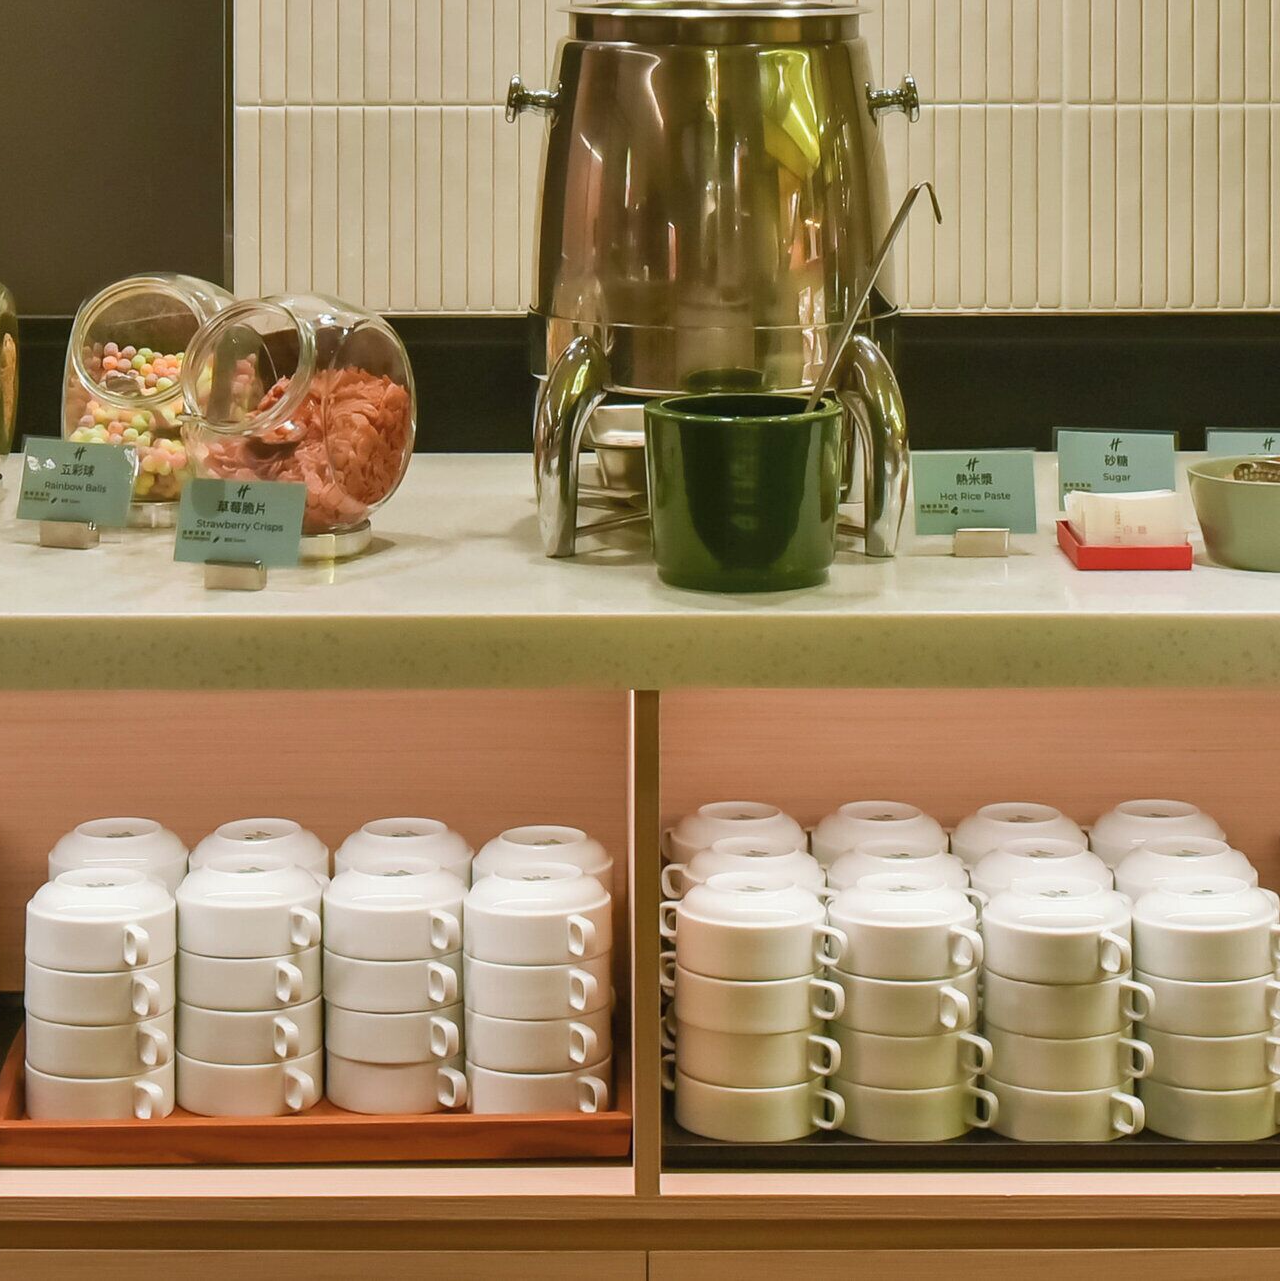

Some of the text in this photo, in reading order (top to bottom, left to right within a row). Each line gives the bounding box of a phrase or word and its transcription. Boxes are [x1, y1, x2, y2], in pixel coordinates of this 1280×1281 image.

[1104, 455, 1128, 467] 砂糖
[61, 464, 96, 477] 五彩球
[956, 473, 993, 485] 熱米漿
[1102, 472, 1131, 483] Sugar
[44, 481, 107, 493] Rainbow Balls
[940, 491, 1011, 501] Hot Rice Paste
[217, 500, 266, 515] 草莓脆片
[196, 518, 283, 533] Strawberry Crisps
